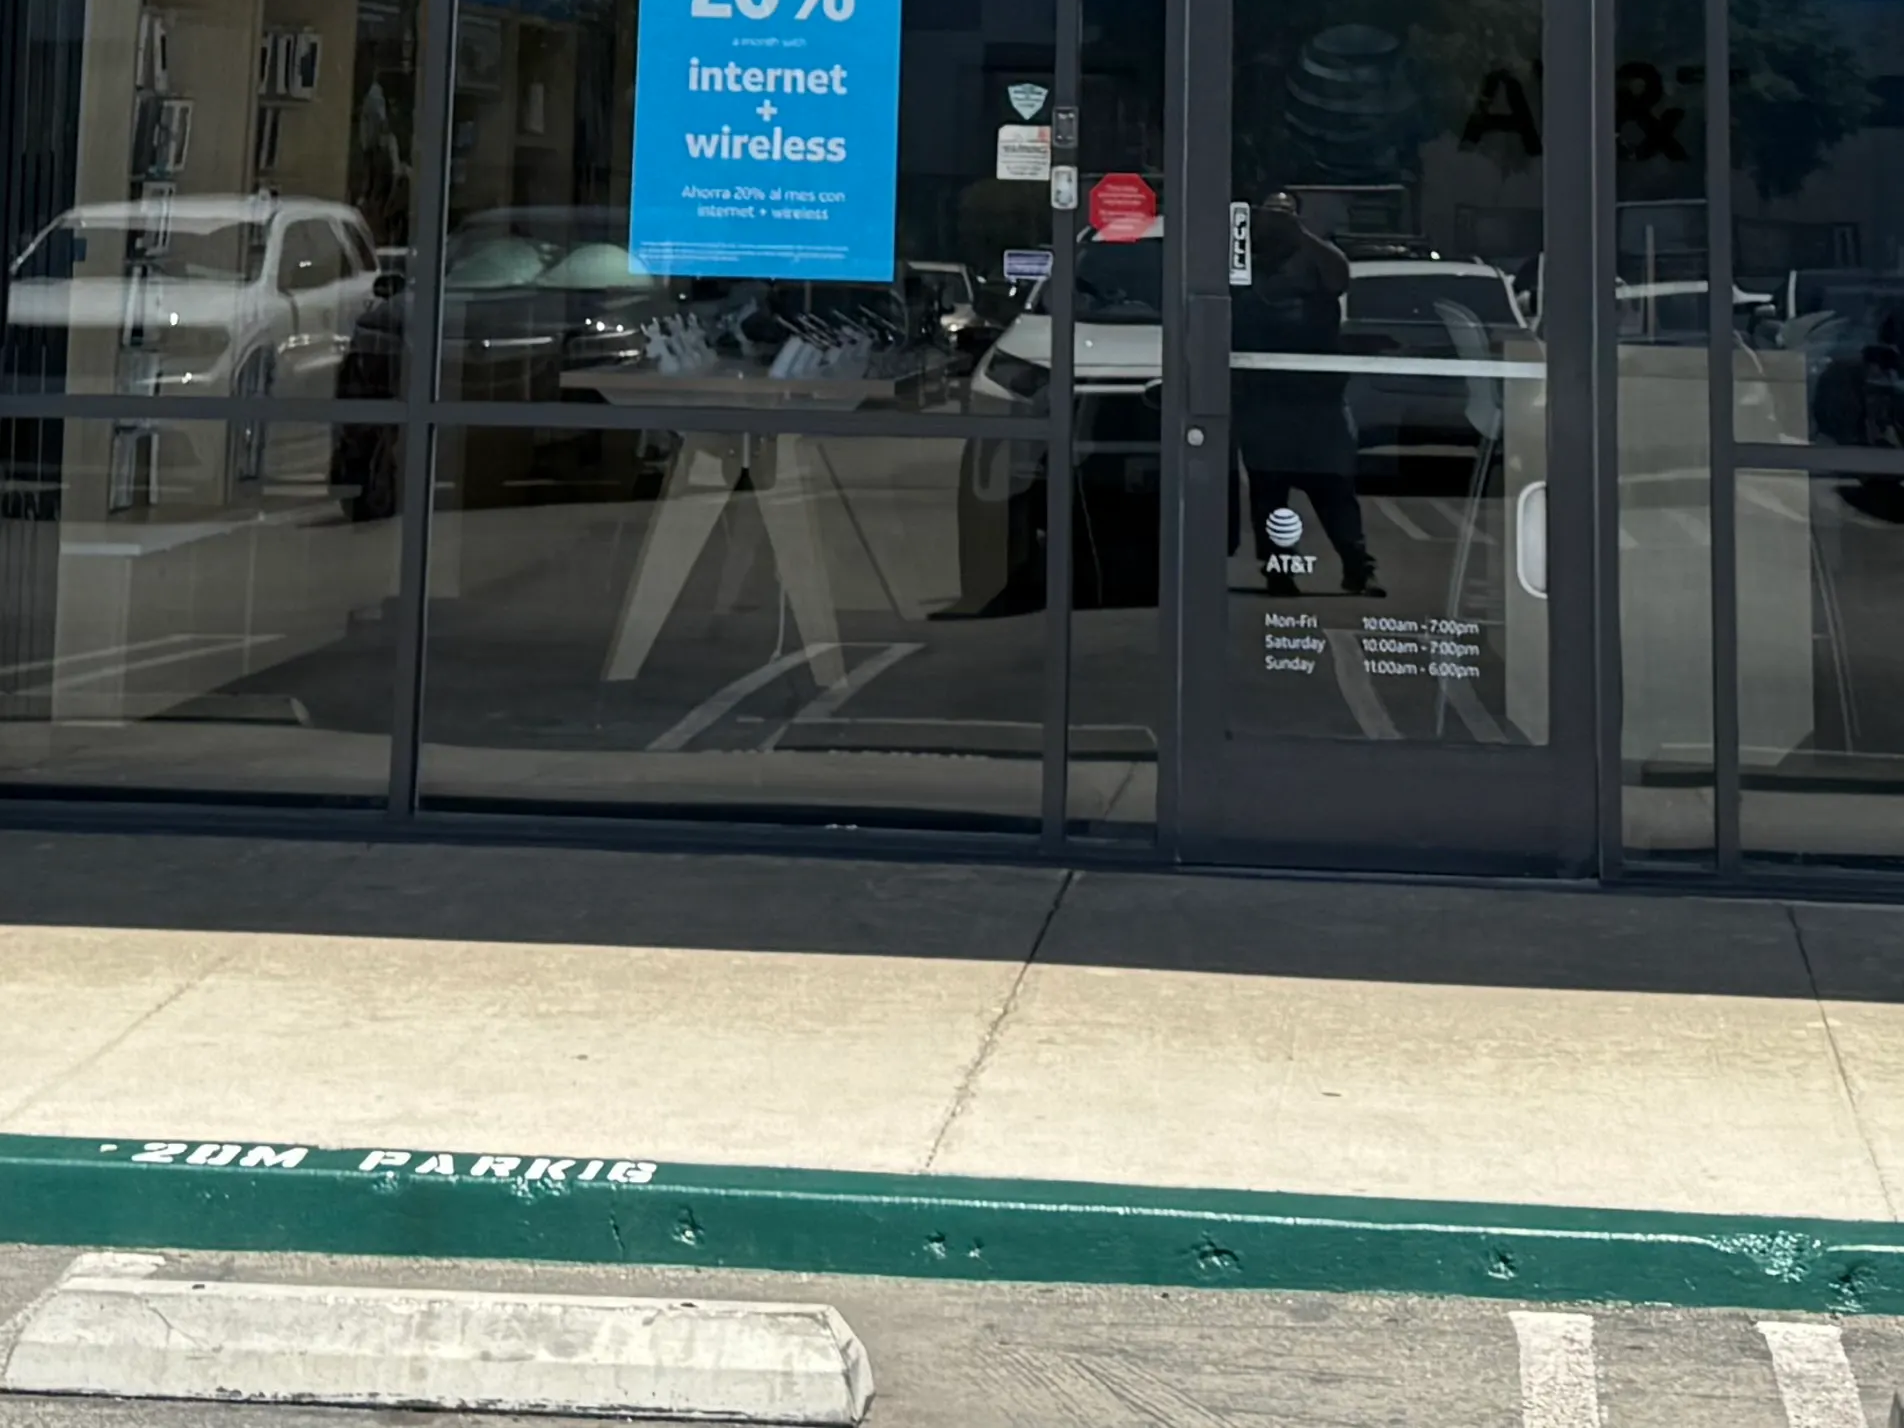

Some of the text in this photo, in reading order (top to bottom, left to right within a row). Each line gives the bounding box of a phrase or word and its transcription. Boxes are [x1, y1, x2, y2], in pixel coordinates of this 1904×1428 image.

[688, 57, 847, 94] internet
[756, 99, 778, 122] +
[685, 124, 846, 162] wireless
[681, 185, 845, 203] Ahorra 20% al mes con
[698, 204, 755, 218] internet
[771, 206, 828, 220] wireless
[1234, 213, 1245, 268] PULL
[1266, 554, 1317, 574] AT&T
[1265, 613, 1317, 629] Mon-Fri
[1265, 634, 1326, 653] Saturday
[1265, 656, 1315, 674] Sunday
